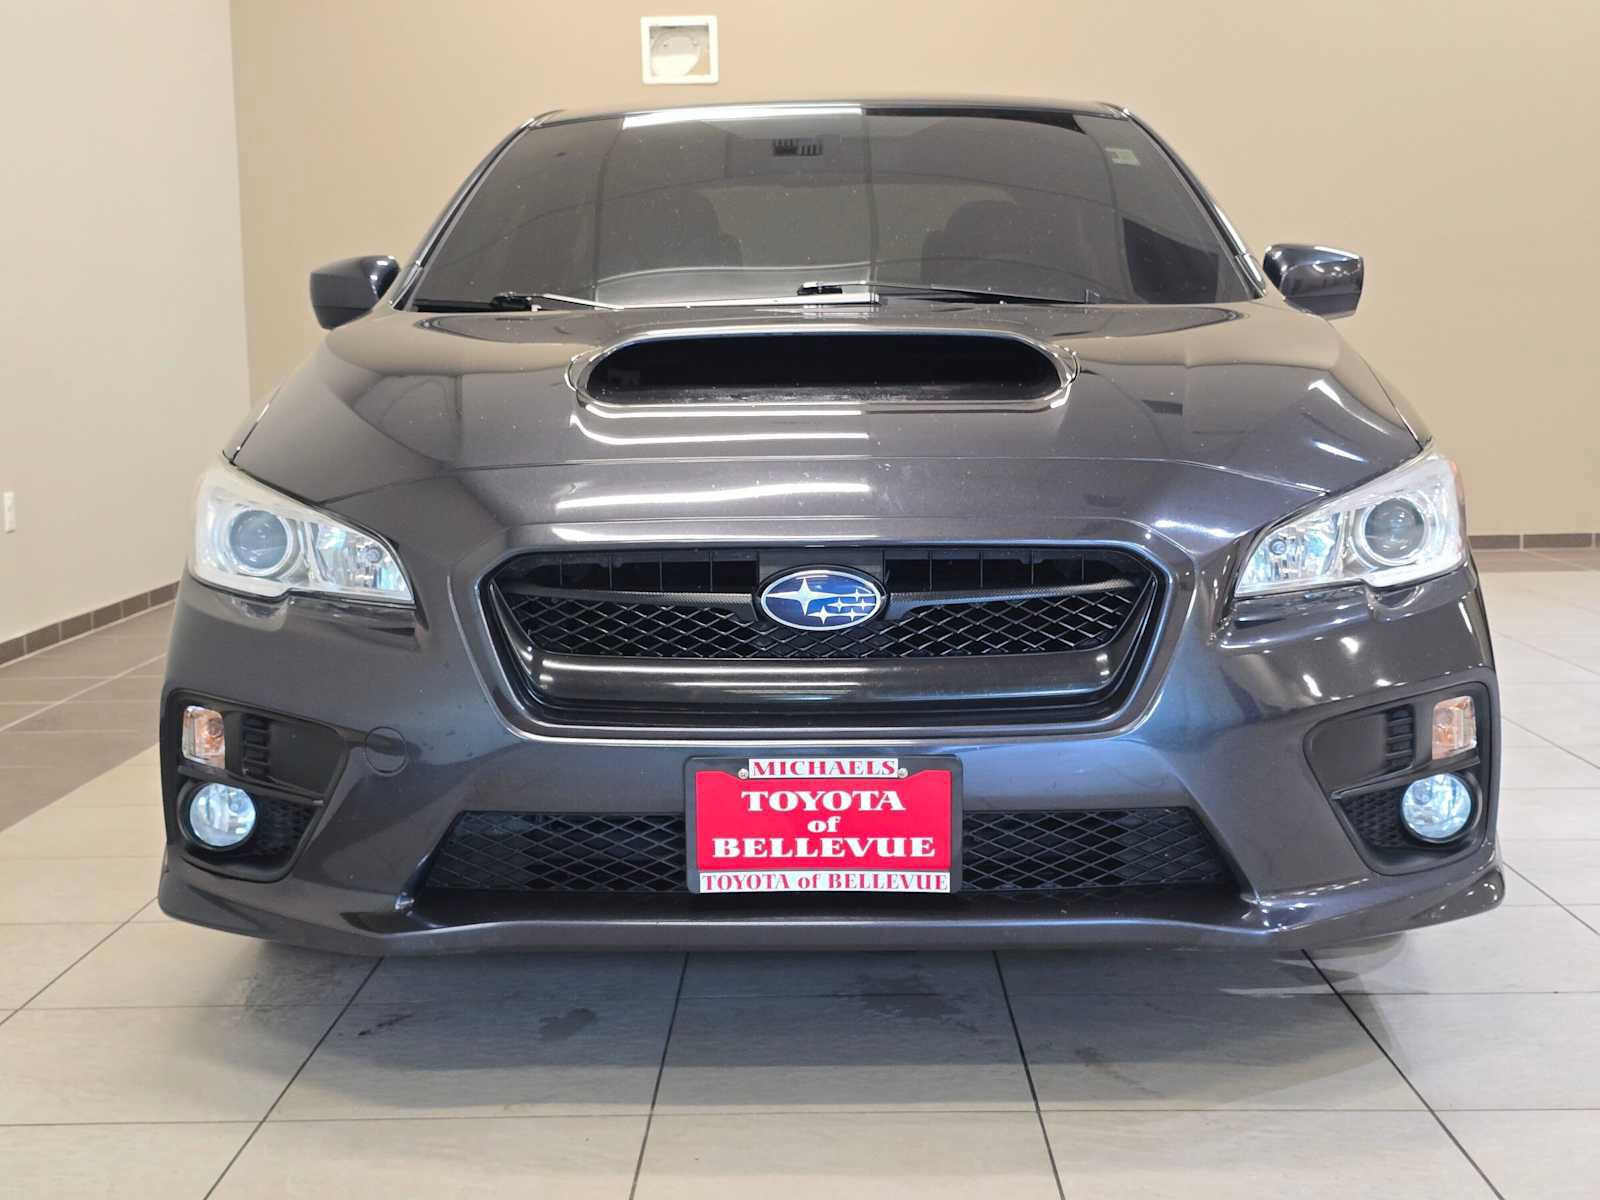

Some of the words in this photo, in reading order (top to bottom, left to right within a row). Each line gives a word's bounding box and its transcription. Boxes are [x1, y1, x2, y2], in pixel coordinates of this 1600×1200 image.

[753, 760, 896, 776] MICHAELS
[740, 790, 906, 812] TOYOTA
[807, 816, 842, 833] of
[712, 837, 936, 859] BELLEVUE
[701, 874, 791, 890] TOYOTA
[797, 874, 821, 889] of
[828, 874, 948, 891] BELLEVUE
